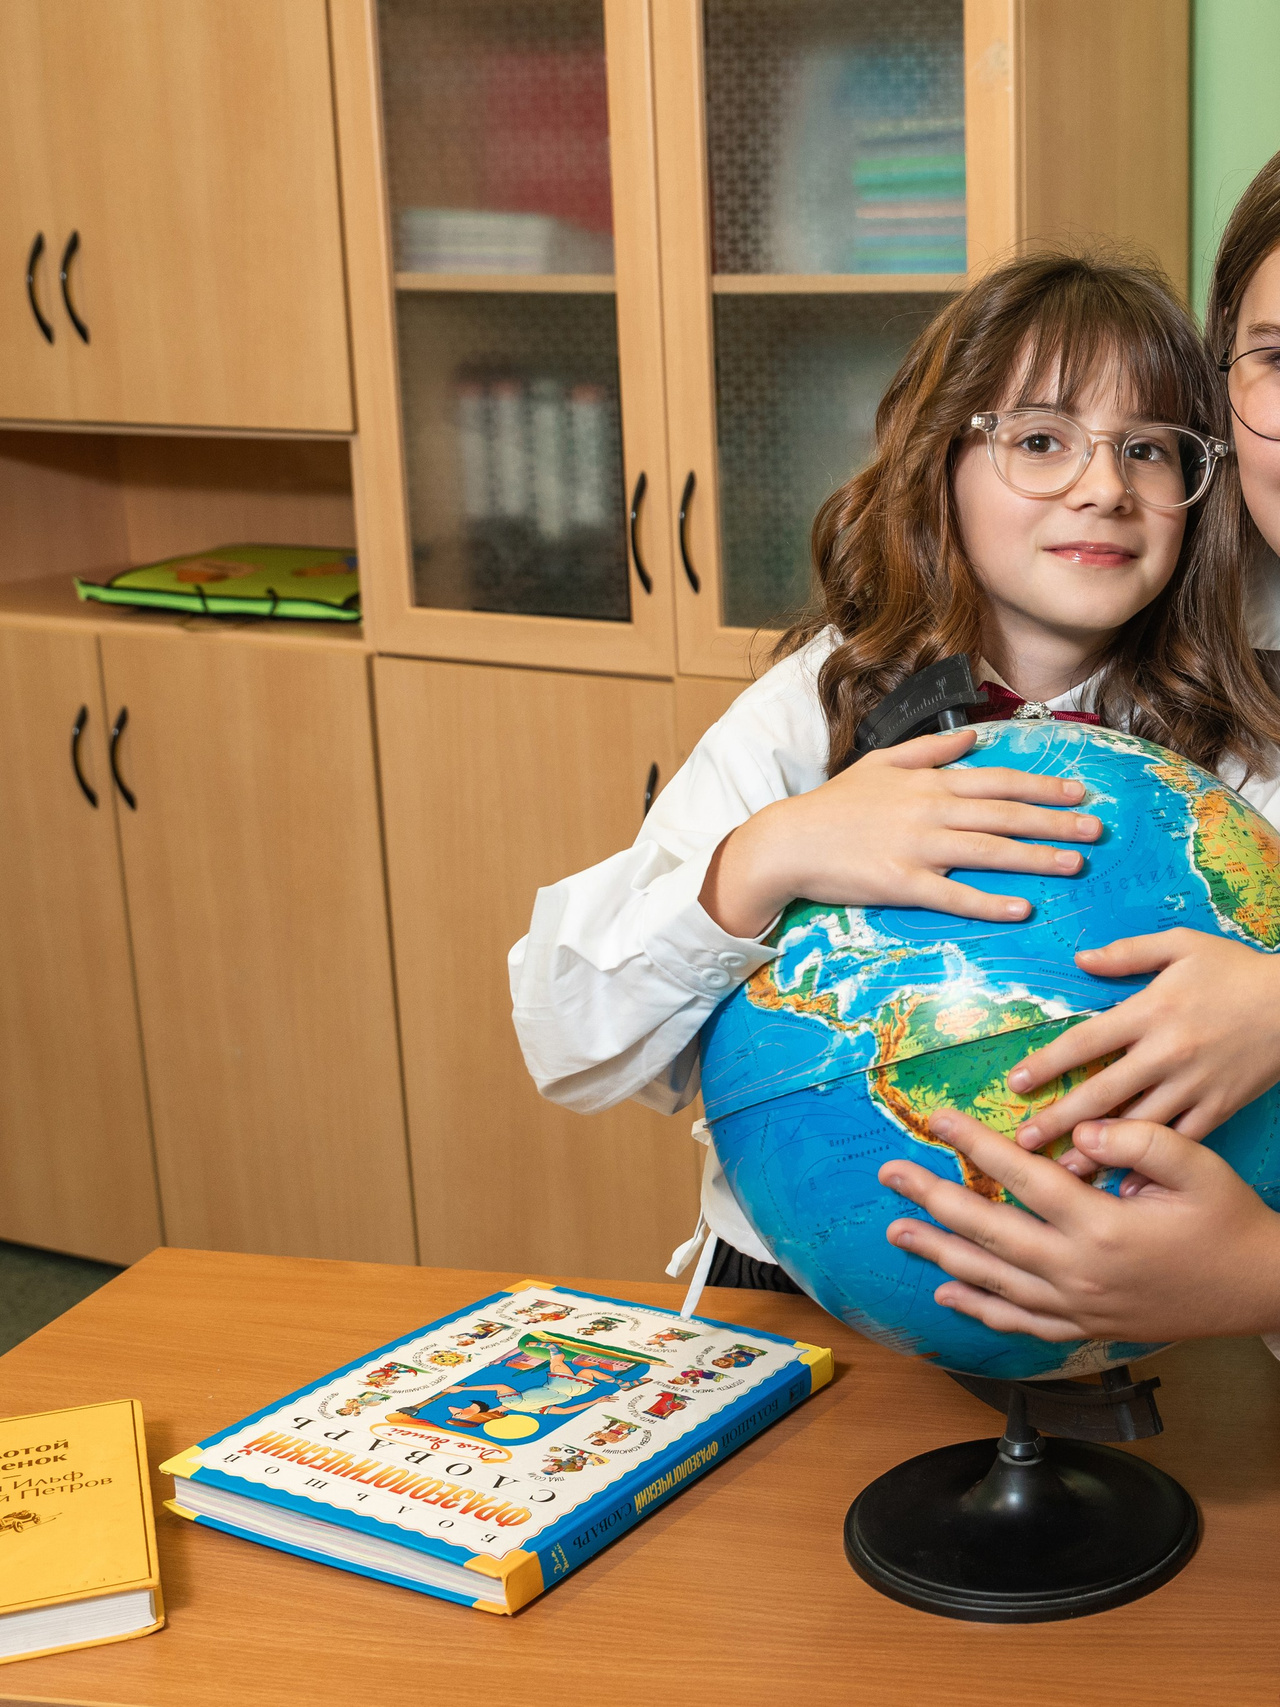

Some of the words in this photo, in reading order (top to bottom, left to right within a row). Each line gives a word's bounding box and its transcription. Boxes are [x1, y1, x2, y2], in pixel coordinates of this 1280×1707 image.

[382, 1427, 450, 1450] детей
[718, 1398, 779, 1448] БОЛЬШОЙ
[0, 1438, 69, 1459] отой
[0, 1453, 68, 1470] енок
[290, 1416, 557, 1504] СЛОВАРЬ
[453, 1441, 503, 1461] Для
[13, 1470, 83, 1489] Ильф
[20, 1477, 112, 1499] Петров
[238, 1430, 533, 1528] ФРАЗЕОЛОГИЧЕСКИЙ
[632, 1439, 718, 1515] ФРАЗЕОЛОГИЧЕСКИЙ
[222, 1453, 499, 1543] БОЛЬШОЙ
[572, 1501, 632, 1549] СЛОВАРЬ
